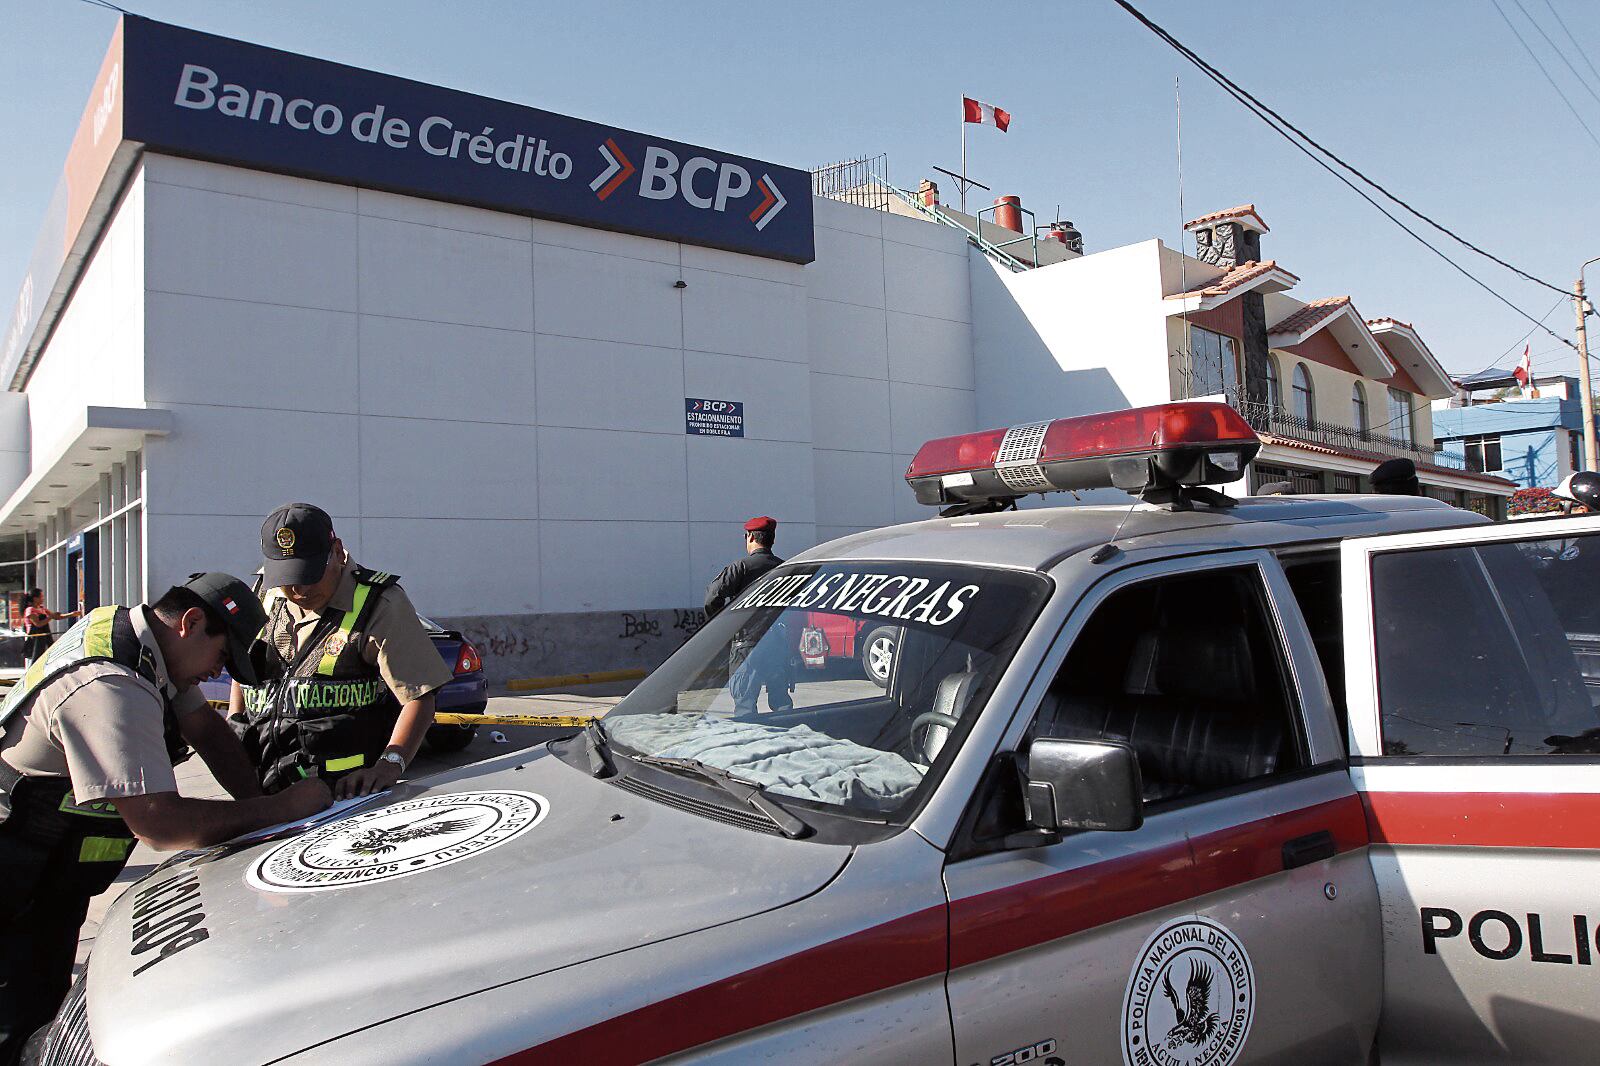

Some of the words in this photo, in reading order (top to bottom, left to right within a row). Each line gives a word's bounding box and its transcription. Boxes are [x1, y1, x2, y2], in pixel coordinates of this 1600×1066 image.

[174, 63, 343, 135] Banco
[351, 104, 410, 148] de
[418, 116, 573, 180] Crédito
[638, 146, 752, 212] BCP
[687, 412, 742, 424] ESTACIONAMIENTO
[703, 401, 727, 411] BCP
[730, 573, 844, 611] AGUILAS
[818, 573, 980, 626] NEGRAS
[435, 835, 499, 860] PERU
[1420, 907, 1600, 966] POLI
[1132, 967, 1155, 1030] POLICIA
[1150, 928, 1205, 966] NACIONAL
[1207, 932, 1227, 956] DEL
[1194, 1020, 1230, 1066] NEGRA
[1226, 1008, 1246, 1051] BANCOS
